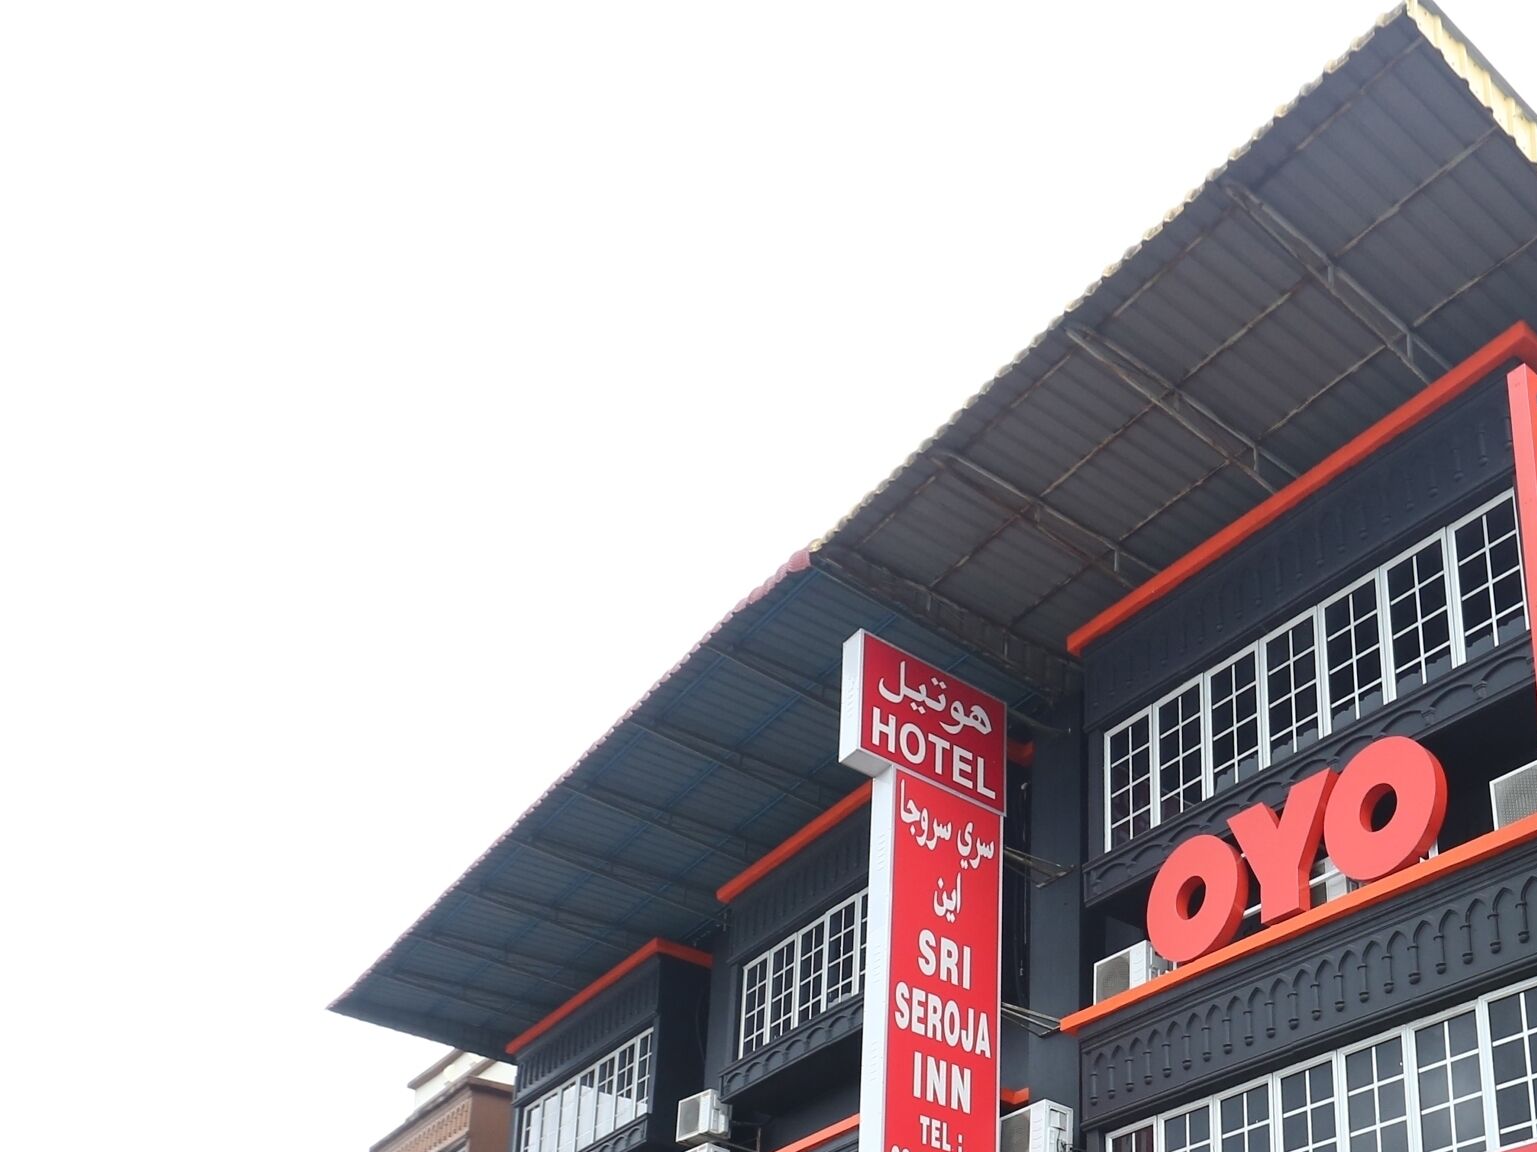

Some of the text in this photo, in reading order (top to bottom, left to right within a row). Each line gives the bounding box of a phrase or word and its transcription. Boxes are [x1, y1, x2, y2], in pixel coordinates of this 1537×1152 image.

[878, 661, 993, 735] هوتيل
[872, 706, 996, 800] HOTEL
[900, 779, 994, 869] سري سروجا
[1146, 734, 1448, 963] OYO
[918, 929, 971, 991] SRI
[894, 981, 992, 1059] SEROJA
[913, 1051, 971, 1115] INN
[919, 1114, 951, 1152] TEL
